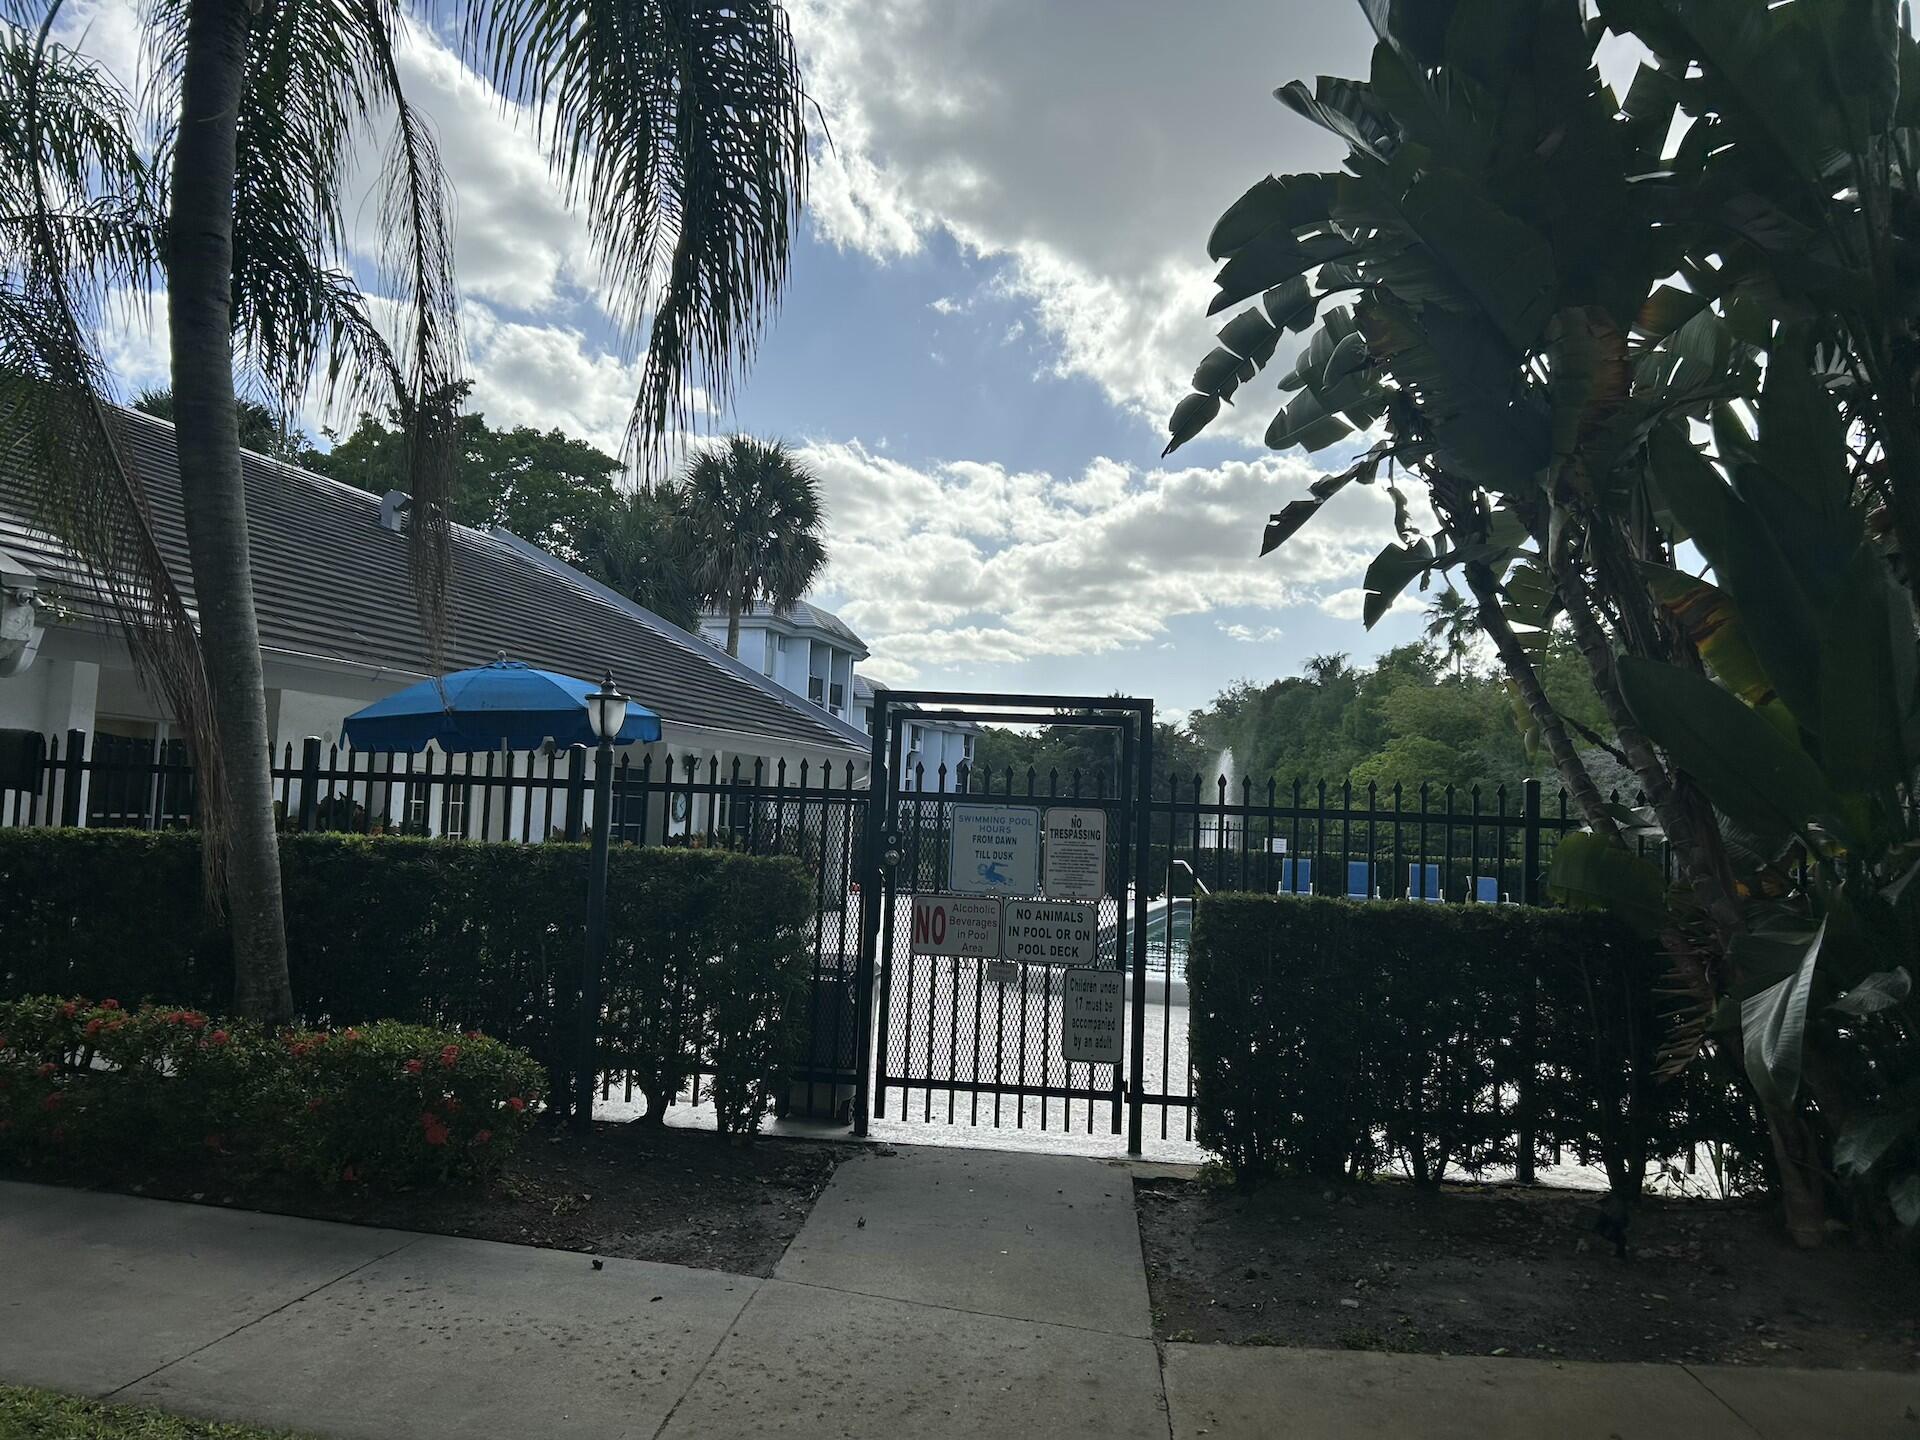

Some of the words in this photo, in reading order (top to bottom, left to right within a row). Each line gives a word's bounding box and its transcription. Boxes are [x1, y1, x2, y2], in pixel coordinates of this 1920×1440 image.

[959, 815, 1005, 824] SWIMMING
[1009, 817, 1033, 826] POOL
[1071, 818, 1082, 829] NO
[979, 825, 1011, 834] HOURS
[1050, 829, 1101, 841] TRESPASSING
[972, 835, 994, 844] FROM
[995, 836, 1017, 845] DAWN
[993, 851, 1014, 860] DUSK
[952, 903, 996, 914] Alcoholic
[1016, 909, 1032, 920] NO
[1035, 910, 1083, 923] ANIMALS
[915, 905, 946, 945] NO
[949, 917, 998, 929] Beverages
[957, 929, 966, 938] in
[968, 931, 989, 941] Pool
[1008, 926, 1019, 937] IN
[1024, 927, 1052, 939] POOL
[1056, 928, 1071, 940] OR
[1075, 930, 1090, 941] ON
[962, 943, 983, 953] Area
[1017, 944, 1047, 955] POOL
[1050, 945, 1079, 958] DECK
[1070, 978, 1097, 993] Children
[1100, 980, 1119, 994] under
[1085, 999, 1102, 1013] must
[1104, 998, 1113, 1013] be
[1072, 1017, 1116, 1032] accompanied
[1074, 1033, 1081, 1051] by
[1084, 1037, 1093, 1048] an
[1095, 1035, 1112, 1049] adult
